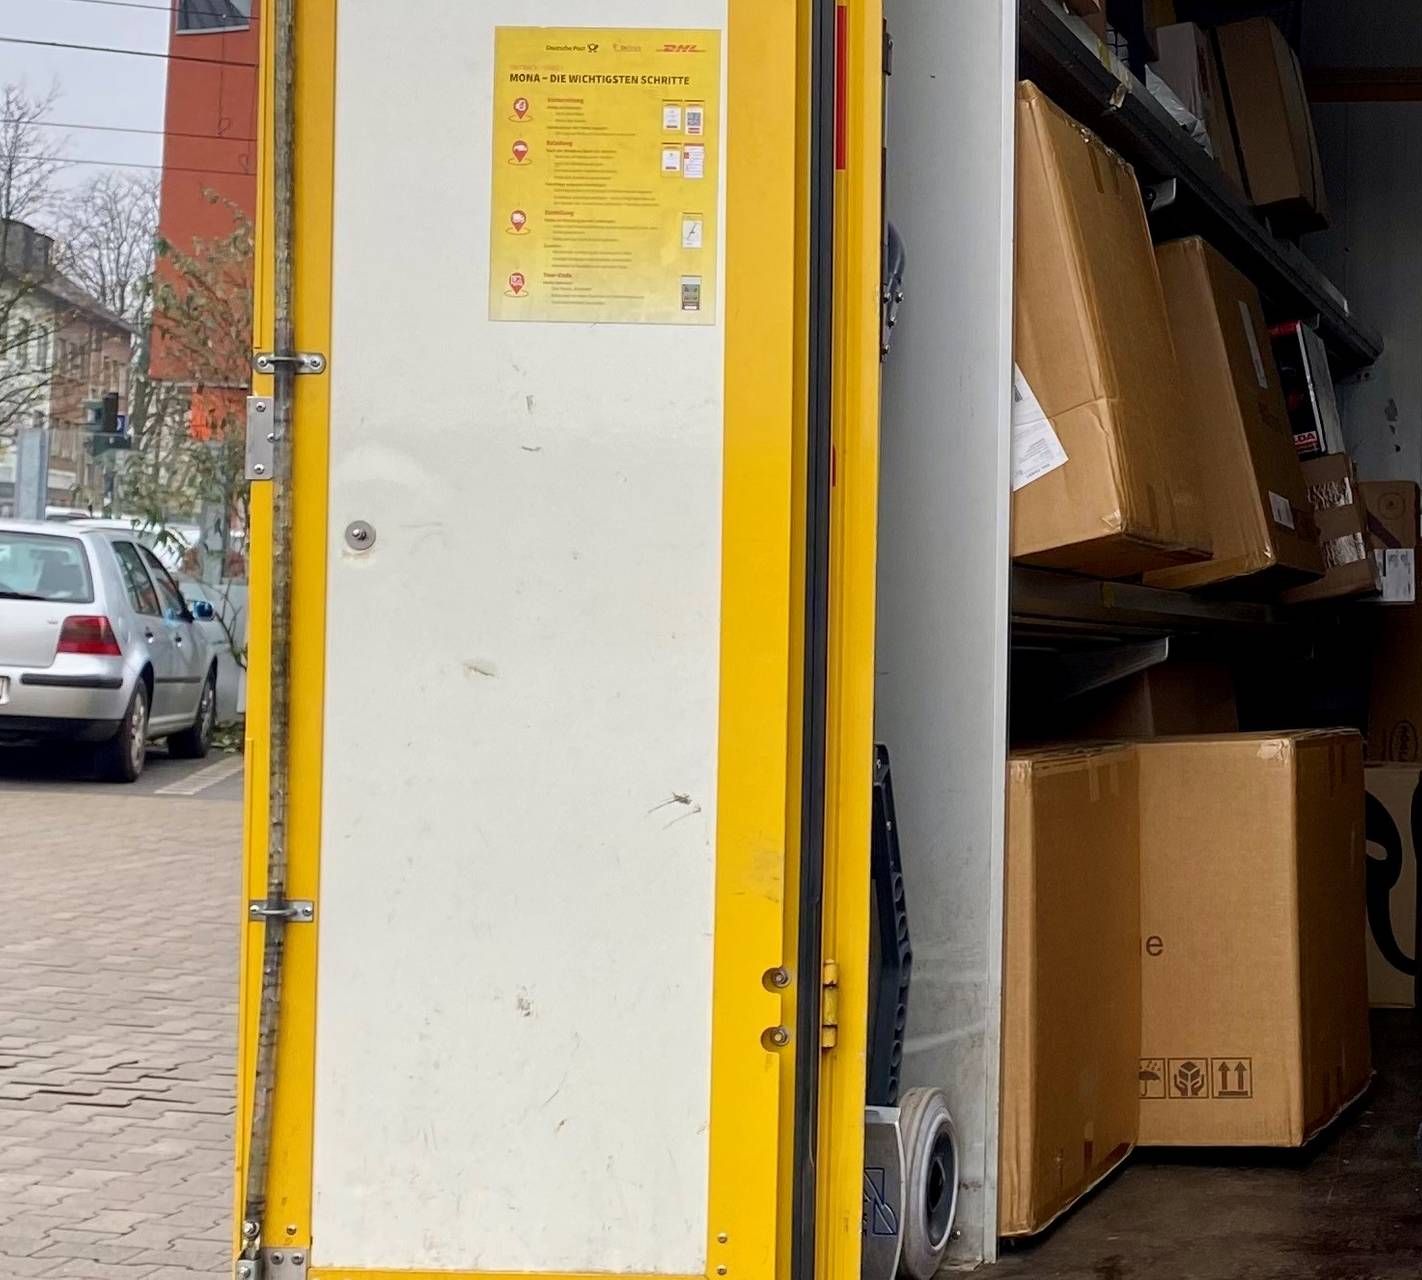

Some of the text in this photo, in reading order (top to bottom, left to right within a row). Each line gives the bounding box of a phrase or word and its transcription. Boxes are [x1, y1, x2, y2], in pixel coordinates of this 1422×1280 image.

[662, 44, 697, 53] DHL
[509, 73, 541, 83] MONA
[550, 74, 567, 84] DIE
[568, 74, 639, 85] WICHTIGSTEN
[640, 75, 690, 86] SCHRITTE
[1140, 935, 1164, 957] e
